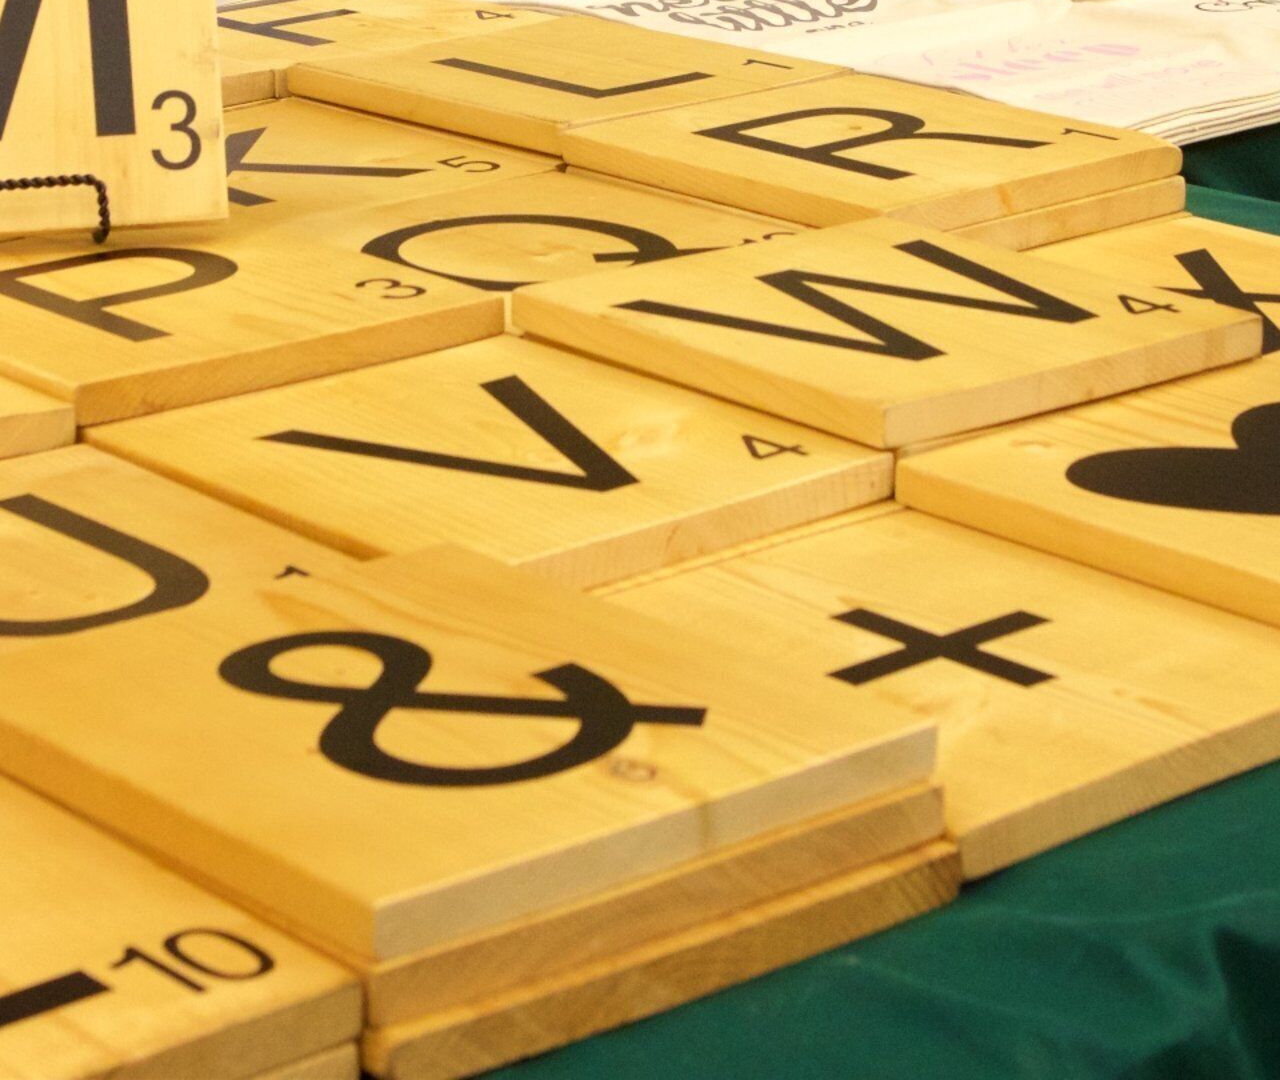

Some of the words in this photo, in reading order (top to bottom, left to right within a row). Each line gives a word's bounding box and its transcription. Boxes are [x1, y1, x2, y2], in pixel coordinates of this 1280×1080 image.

[149, 89, 203, 172] 3
[691, 106, 1057, 181] R
[609, 238, 1101, 363] W
[255, 374, 642, 493] V
[218, 630, 708, 789] &
[109, 925, 276, 994] 10
